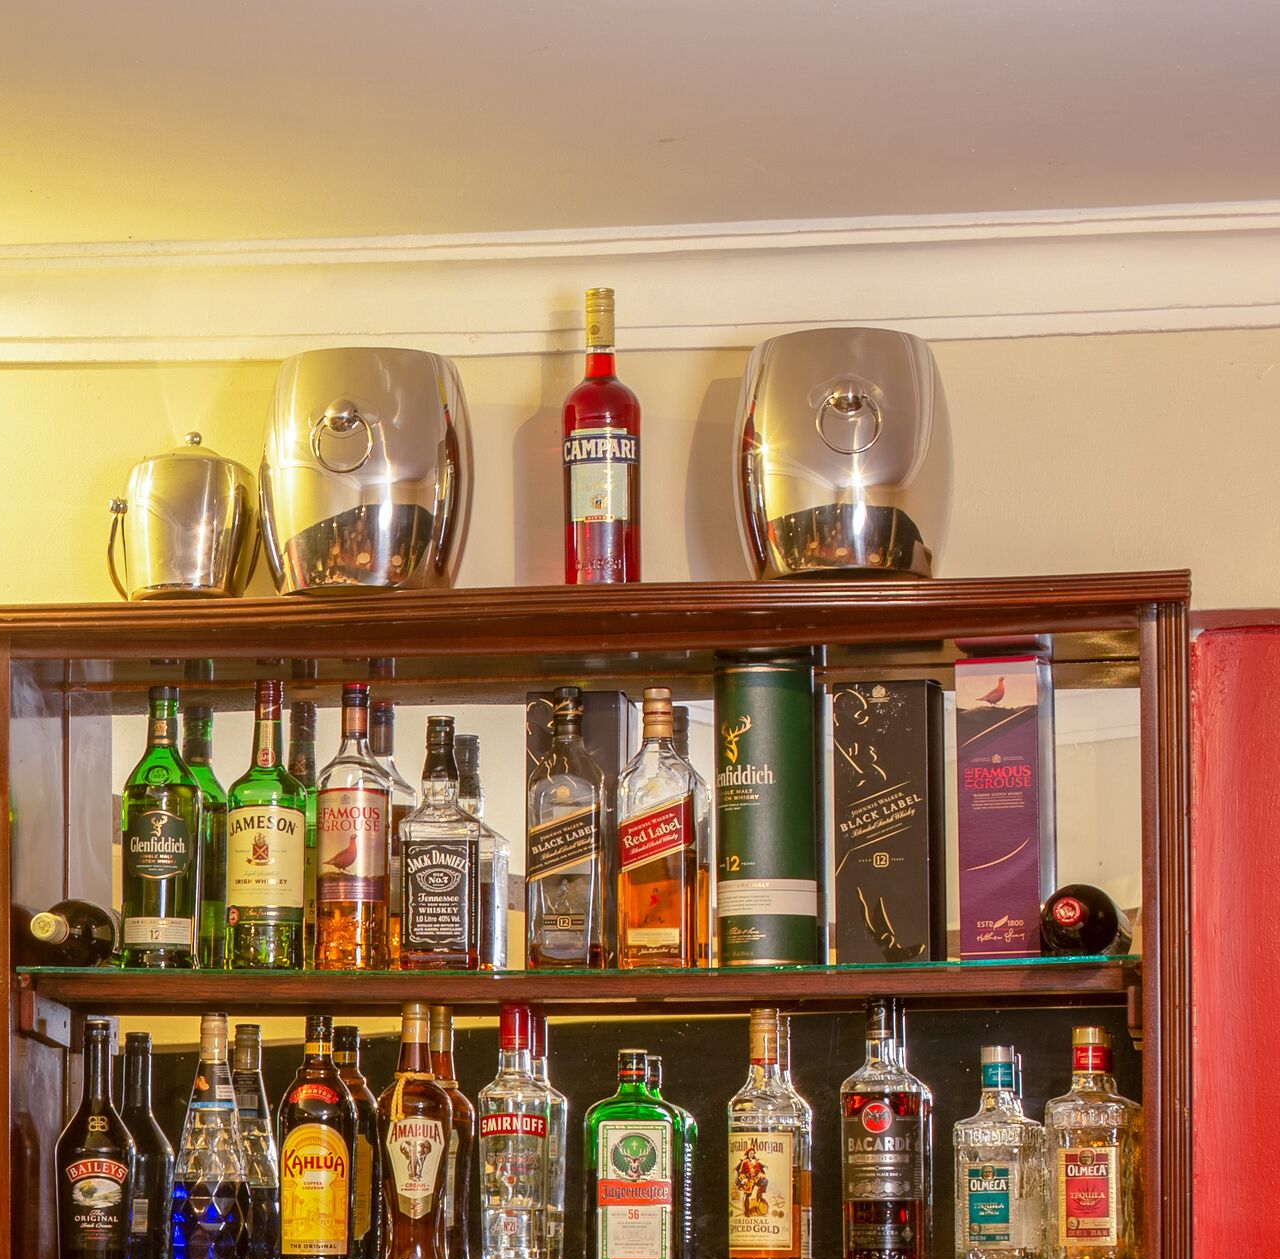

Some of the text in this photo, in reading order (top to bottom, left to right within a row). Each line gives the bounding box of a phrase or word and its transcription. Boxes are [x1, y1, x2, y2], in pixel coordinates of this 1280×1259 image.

[563, 438, 636, 462] CAMPARI
[964, 767, 973, 790] THE
[974, 764, 1032, 780] FAMOUS
[973, 776, 1032, 789] GROUSE
[851, 791, 905, 817] JOHNNIE WALKER
[322, 806, 380, 820] FAMOUS
[840, 809, 880, 832] BLACK
[882, 793, 922, 815] LABEL
[229, 815, 296, 837] JAMESON
[322, 819, 380, 832] GROUSE
[623, 818, 682, 849] Red Label
[130, 836, 185, 853] Glenfiddich
[531, 824, 598, 855] BLACK LABEL
[407, 853, 432, 874] JACK
[726, 855, 740, 872] 12
[875, 855, 887, 865] 12
[418, 892, 460, 902] Tennessee
[418, 906, 459, 914] WHISKEY
[559, 918, 569, 927] 12
[1007, 919, 1024, 927] 1800
[149, 929, 161, 940] 12
[482, 1116, 544, 1134] SMIRNOFF
[390, 1122, 442, 1145] AMARULA
[748, 1137, 784, 1155] Morgan
[847, 1133, 911, 1152] BACARDÍ
[69, 1161, 126, 1178] BAILEYS
[284, 1149, 346, 1179] KAHLÚA
[1067, 1164, 1107, 1177] OLMECA
[970, 1179, 1007, 1191] OLMECA
[1069, 1191, 1106, 1200] TEQUILA
[89, 1209, 105, 1217] The
[627, 1208, 640, 1220] 56
[753, 1224, 780, 1235] GOLD
